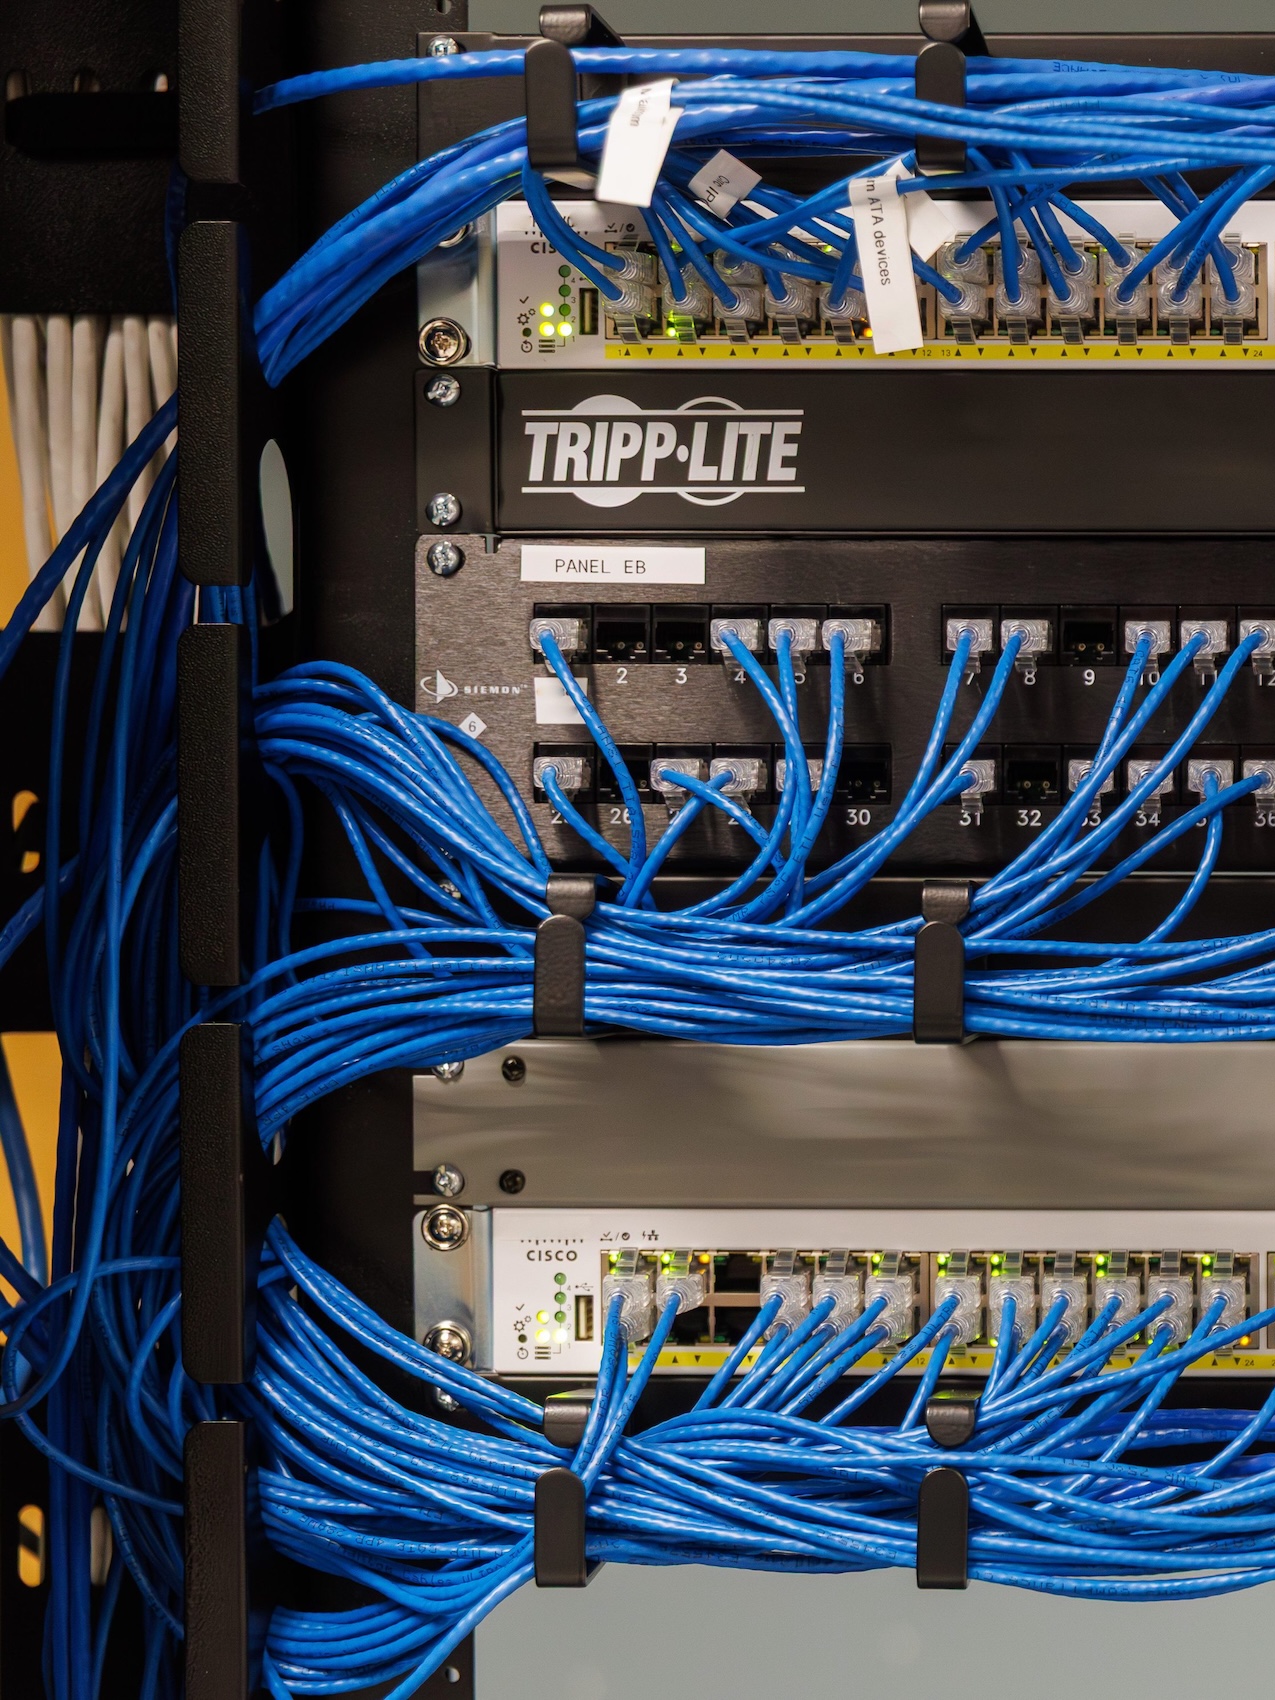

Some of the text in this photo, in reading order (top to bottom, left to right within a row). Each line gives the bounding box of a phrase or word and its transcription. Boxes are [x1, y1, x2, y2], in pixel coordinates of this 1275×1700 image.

[868, 196, 884, 226] ATA
[531, 242, 558, 254] CIS
[873, 230, 891, 286] devices
[1253, 350, 1264, 358] 24
[555, 559, 646, 574] PANEL EB
[616, 667, 628, 684] 2
[675, 668, 688, 684] 3
[734, 670, 746, 684] 4
[853, 673, 865, 684] 6
[1024, 670, 1036, 686] 8
[1083, 670, 1096, 686] 9
[1140, 670, 1160, 686] 10
[468, 720, 477, 732] 6
[846, 808, 872, 826] 30
[959, 811, 982, 826] 31
[1017, 810, 1042, 826] 32
[1136, 811, 1161, 826] 34
[526, 1250, 578, 1262] CISCO
[916, 1358, 926, 1366] 12
